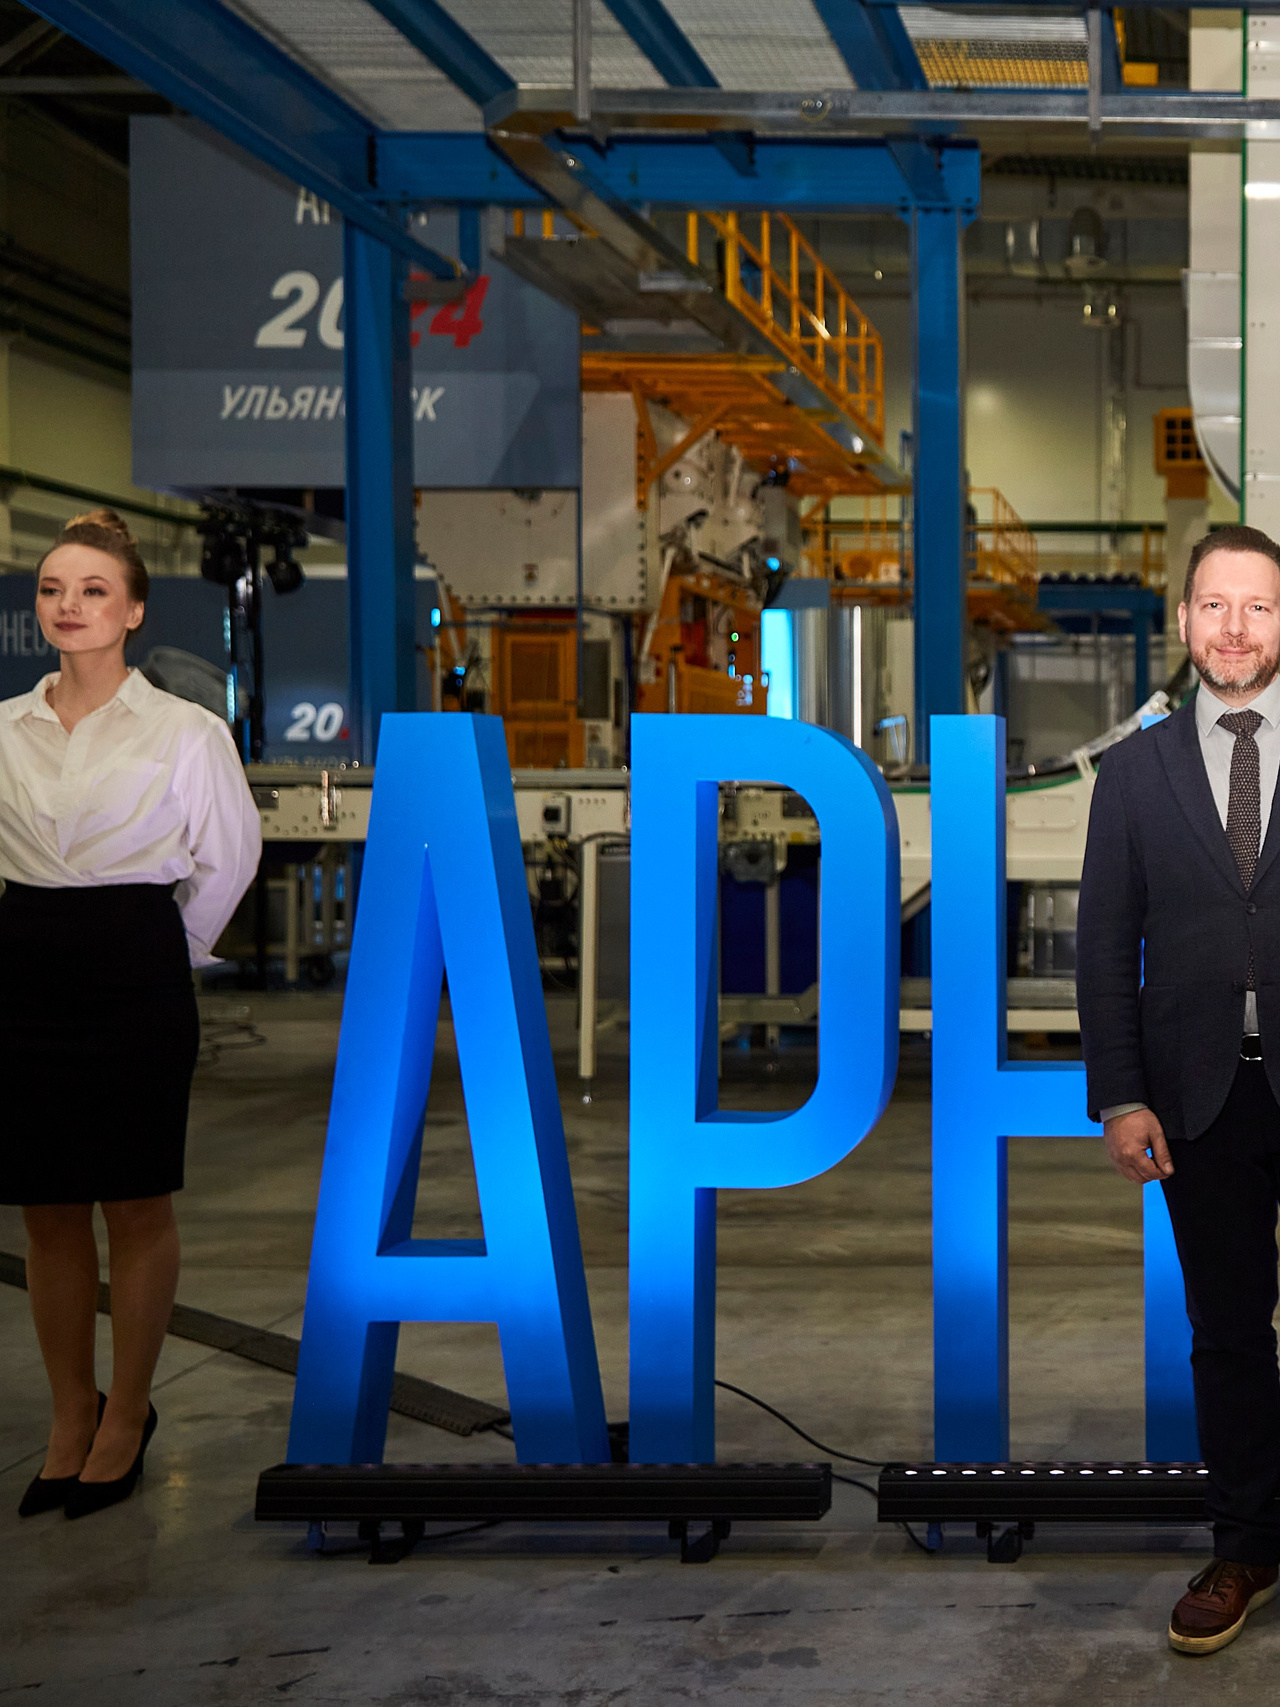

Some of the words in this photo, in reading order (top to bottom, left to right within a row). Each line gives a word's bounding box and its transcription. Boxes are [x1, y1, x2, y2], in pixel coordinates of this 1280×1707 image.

[255, 269, 491, 350] 24
[220, 384, 446, 421] УЛЬЯНК
[284, 701, 350, 742] 20
